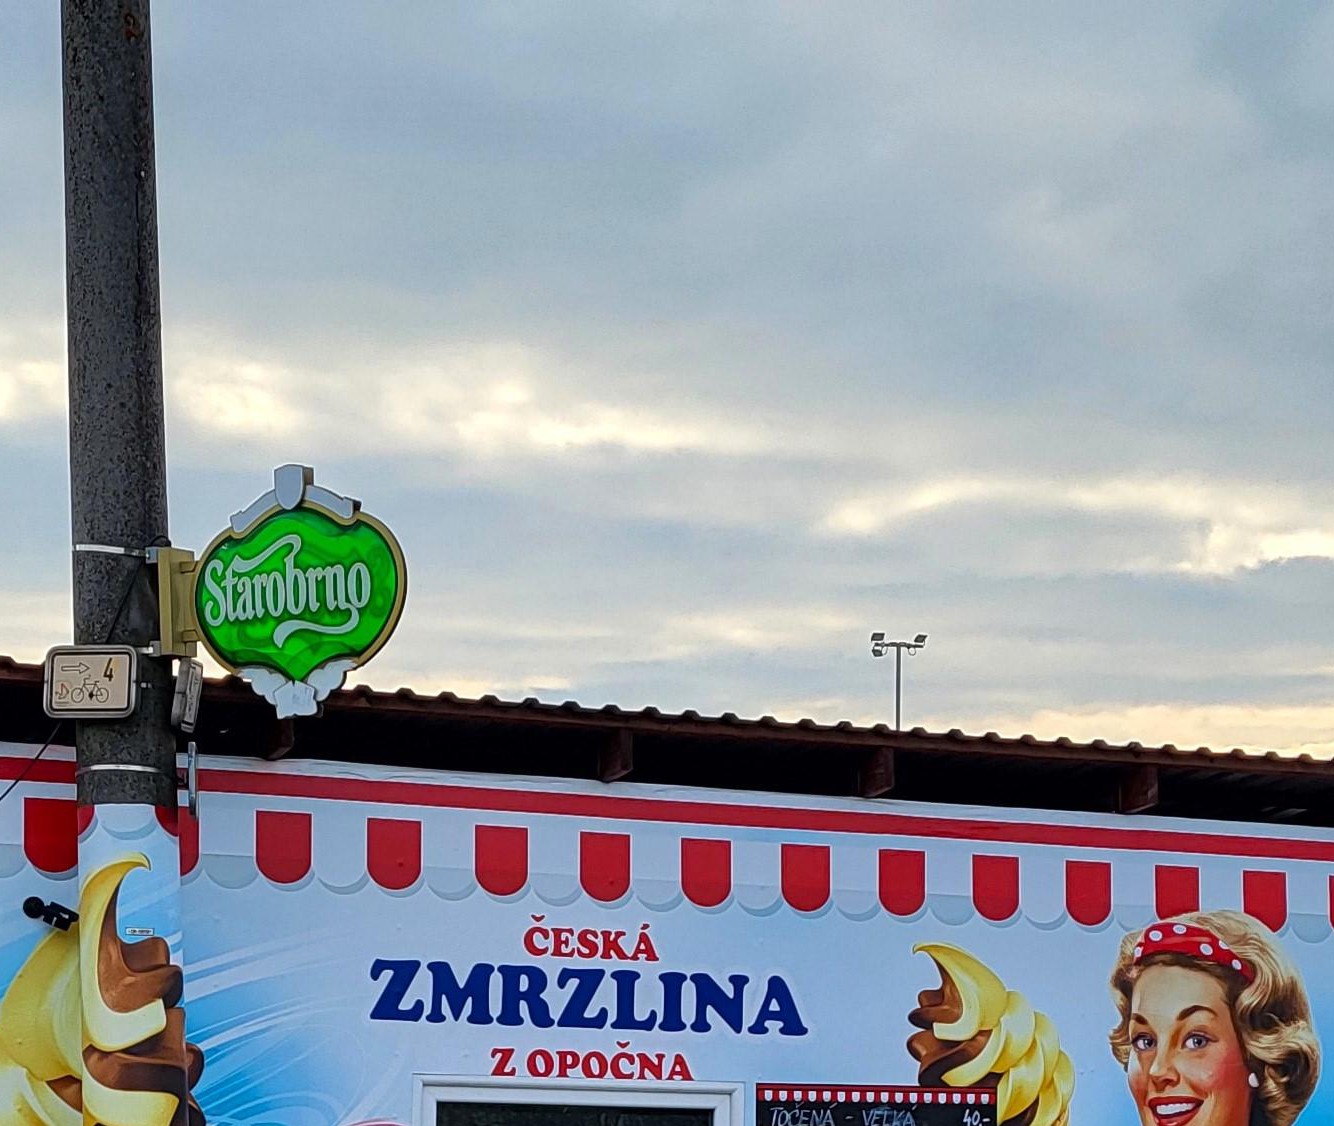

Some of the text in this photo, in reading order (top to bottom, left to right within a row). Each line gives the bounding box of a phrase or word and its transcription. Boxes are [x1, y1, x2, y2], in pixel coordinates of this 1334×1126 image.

[204, 534, 371, 648] Starobrno
[103, 658, 114, 682] 4
[523, 914, 659, 962] ČESKÁ
[370, 958, 808, 1036] ZMRZLINA
[490, 1041, 694, 1081] Z OPOČNA
